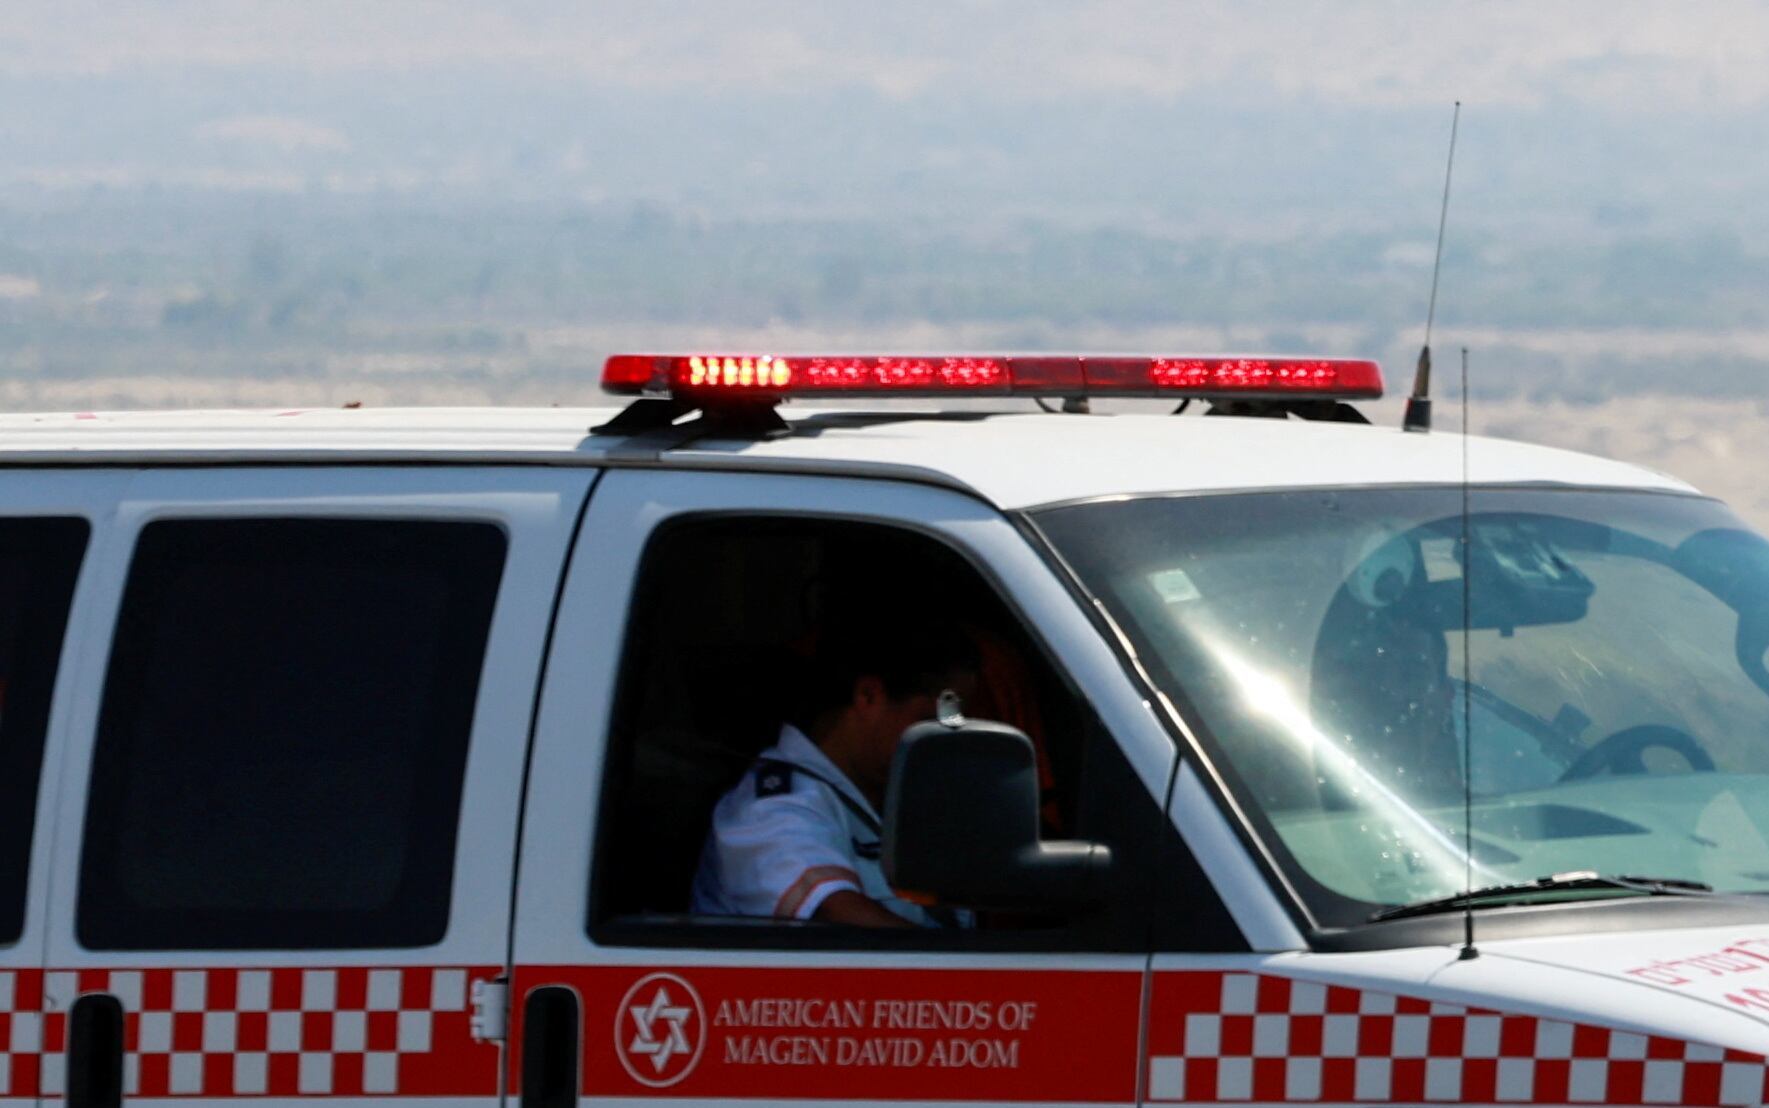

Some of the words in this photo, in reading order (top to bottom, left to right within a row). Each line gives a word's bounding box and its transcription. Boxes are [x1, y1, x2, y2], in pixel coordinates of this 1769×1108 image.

[713, 998, 863, 1029] AMERICAN
[872, 999, 992, 1031] FRIENDS
[999, 1001, 1038, 1031] OF
[723, 1035, 830, 1066] MAGEN
[836, 1036, 924, 1068] DAVID
[926, 1039, 1021, 1069] ADOM
